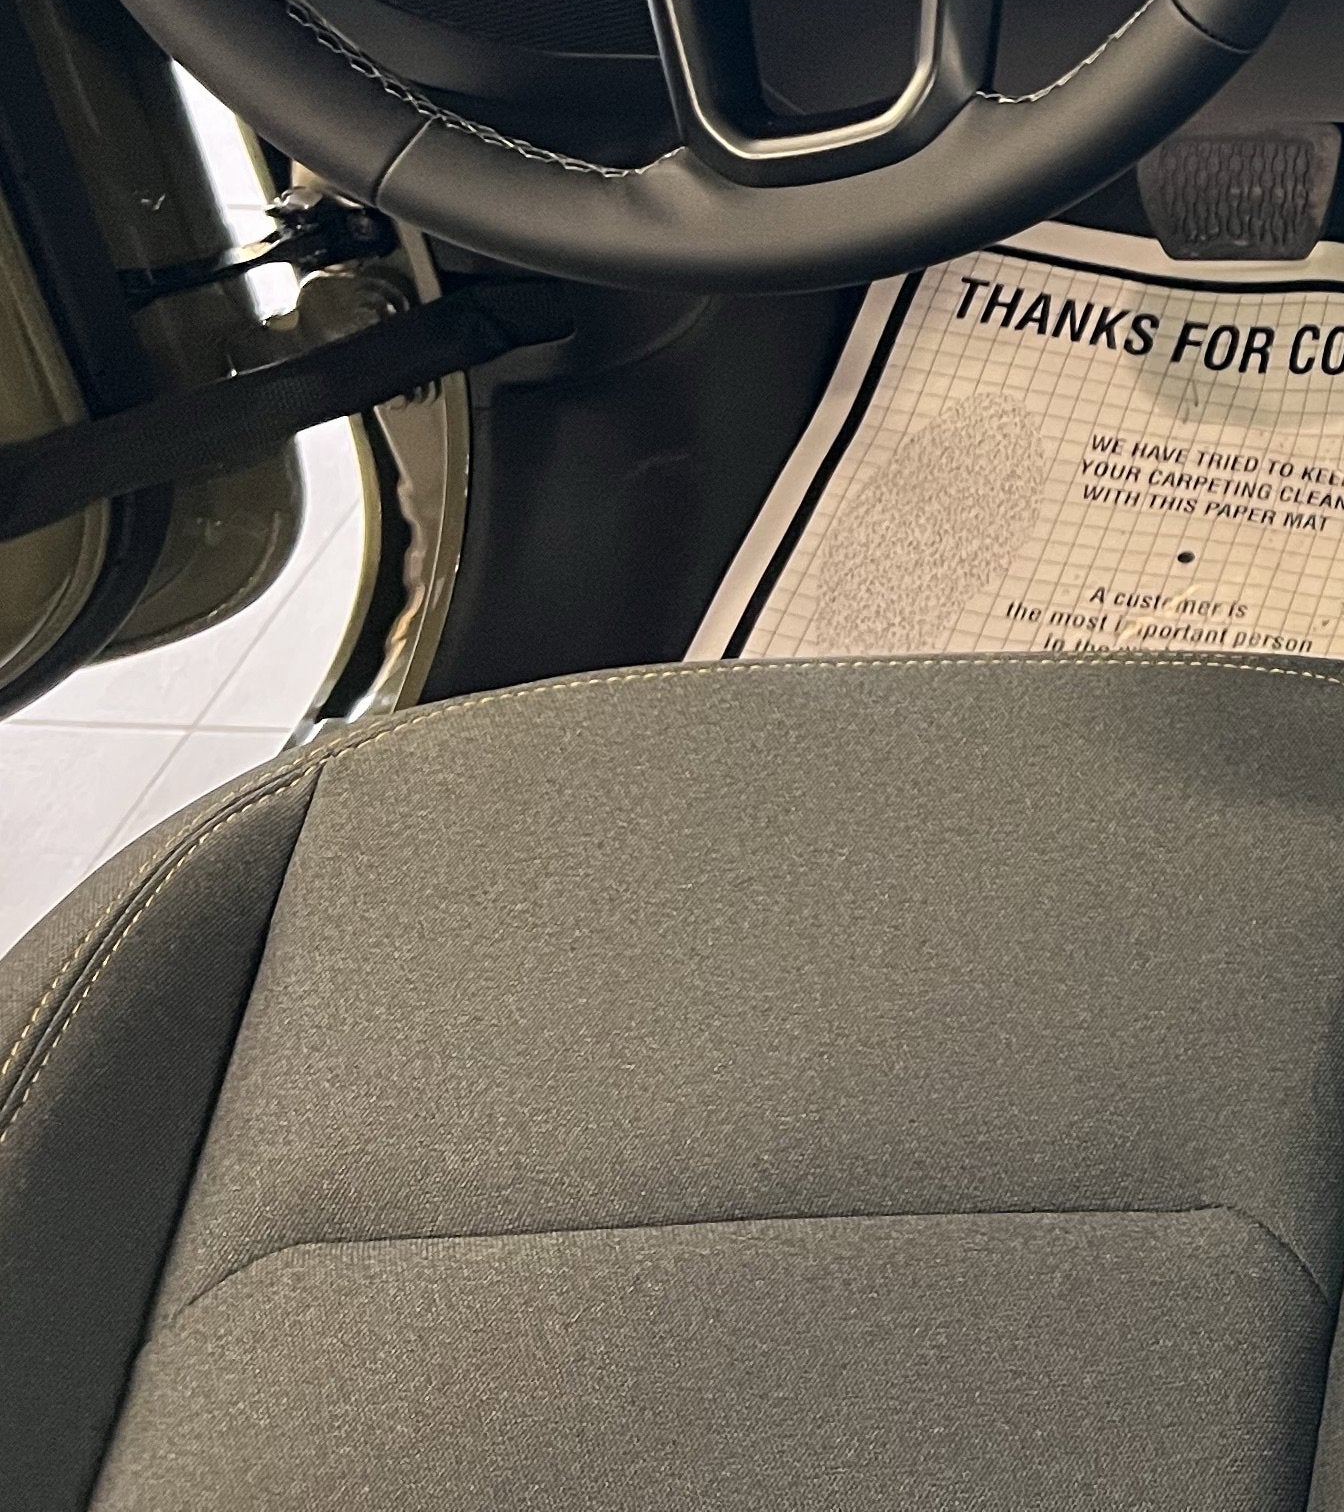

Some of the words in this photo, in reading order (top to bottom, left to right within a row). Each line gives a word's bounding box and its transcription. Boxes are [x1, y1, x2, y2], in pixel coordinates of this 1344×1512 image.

[956, 277, 1160, 356] THANKS
[1170, 320, 1275, 374] FOR
[1091, 434, 1127, 456] WE
[1131, 441, 1189, 464] HAVE
[1196, 450, 1259, 473] TRIED
[1267, 458, 1294, 478] TO
[1081, 458, 1141, 483] YOUR
[1148, 468, 1273, 501] CARPETING
[1082, 484, 1141, 508] WITH
[1149, 492, 1199, 514] THIS
[1203, 501, 1277, 526] PAPER
[1283, 511, 1332, 533] MAT
[1089, 586, 1106, 605] A
[1228, 599, 1249, 619] is
[1006, 599, 1042, 623] the
[1050, 609, 1108, 631] most
[1231, 629, 1314, 654] person
